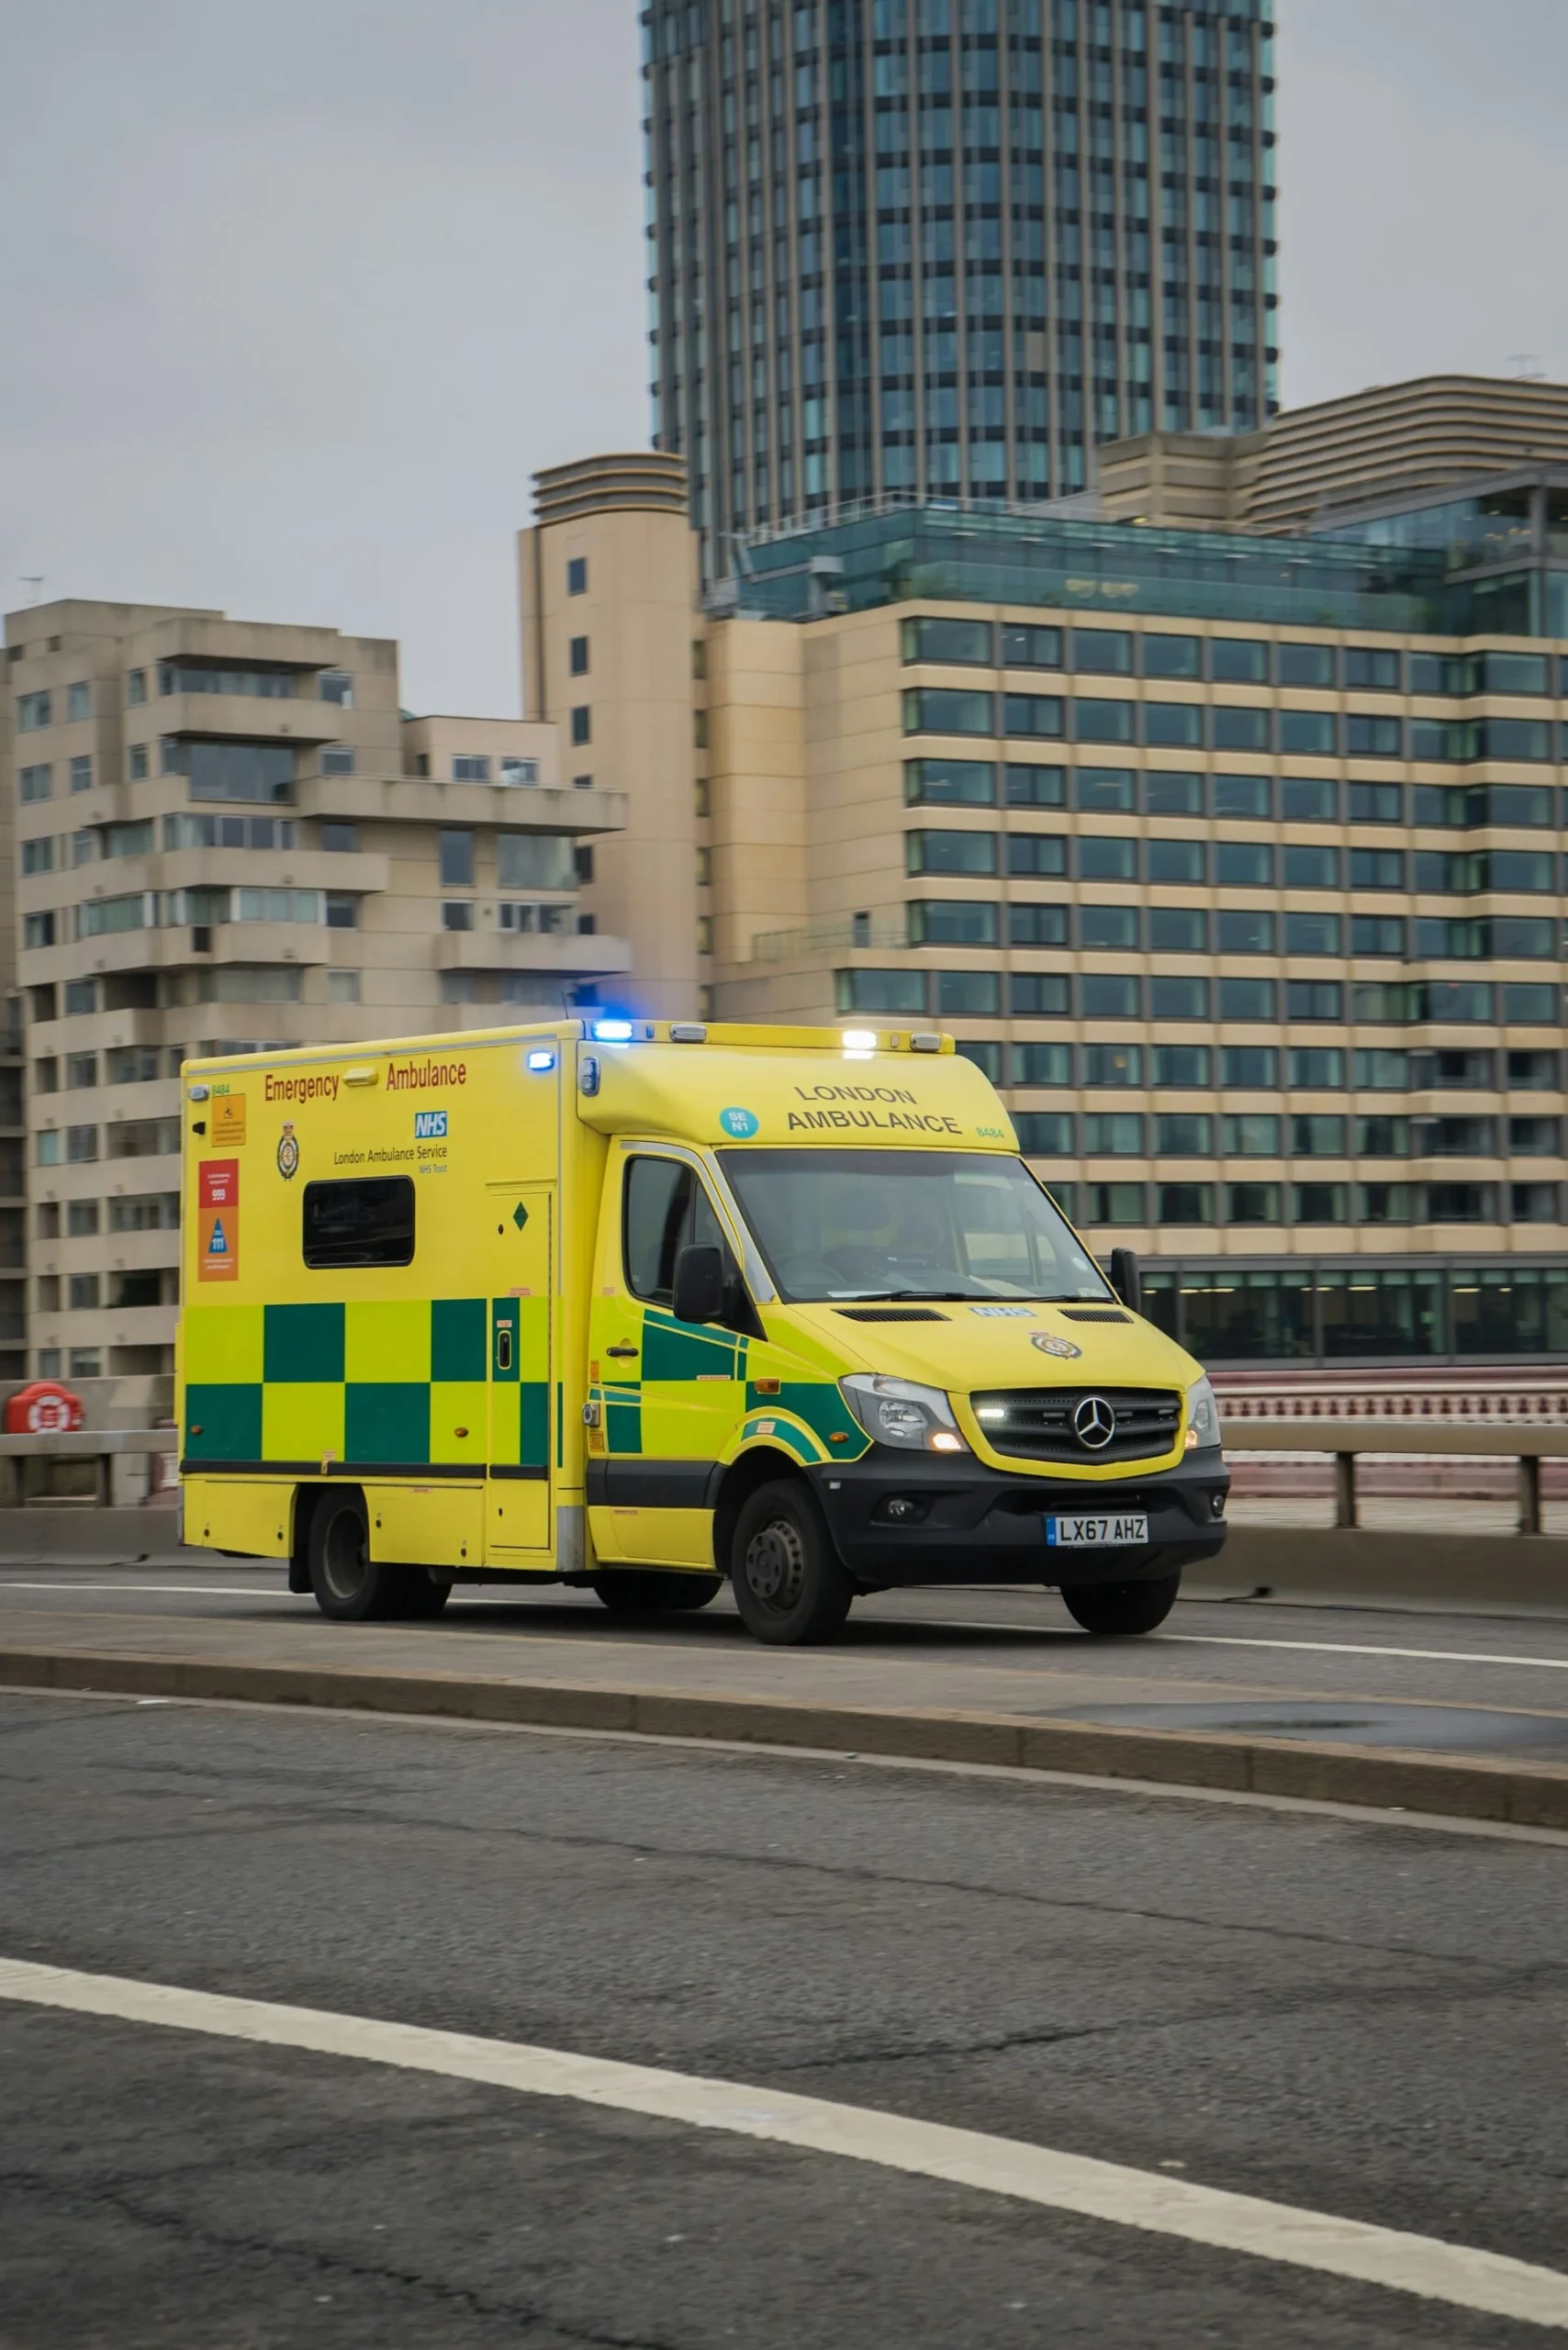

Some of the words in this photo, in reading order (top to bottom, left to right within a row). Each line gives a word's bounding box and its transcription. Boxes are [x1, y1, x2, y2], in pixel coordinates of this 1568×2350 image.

[265, 1074, 339, 1103] Emergency
[386, 1059, 466, 1091] Ambulance
[794, 1085, 918, 1105] LONDON
[728, 1112, 746, 1121] SE
[787, 1110, 963, 1135] AMBULANCE
[416, 1113, 447, 1137] NHS
[731, 1122, 748, 1132] N1
[975, 1126, 1005, 1139] 8484
[333, 1150, 365, 1165] London
[366, 1147, 415, 1162] Ambulance
[417, 1144, 447, 1159] Service
[420, 1164, 431, 1174] NHS
[432, 1163, 447, 1173] Trust
[212, 1188, 226, 1201] 999
[212, 1237, 225, 1250] 111
[971, 1308, 1036, 1317] NHS
[1060, 1519, 1108, 1541] LX67
[1114, 1518, 1145, 1539] AHZ
